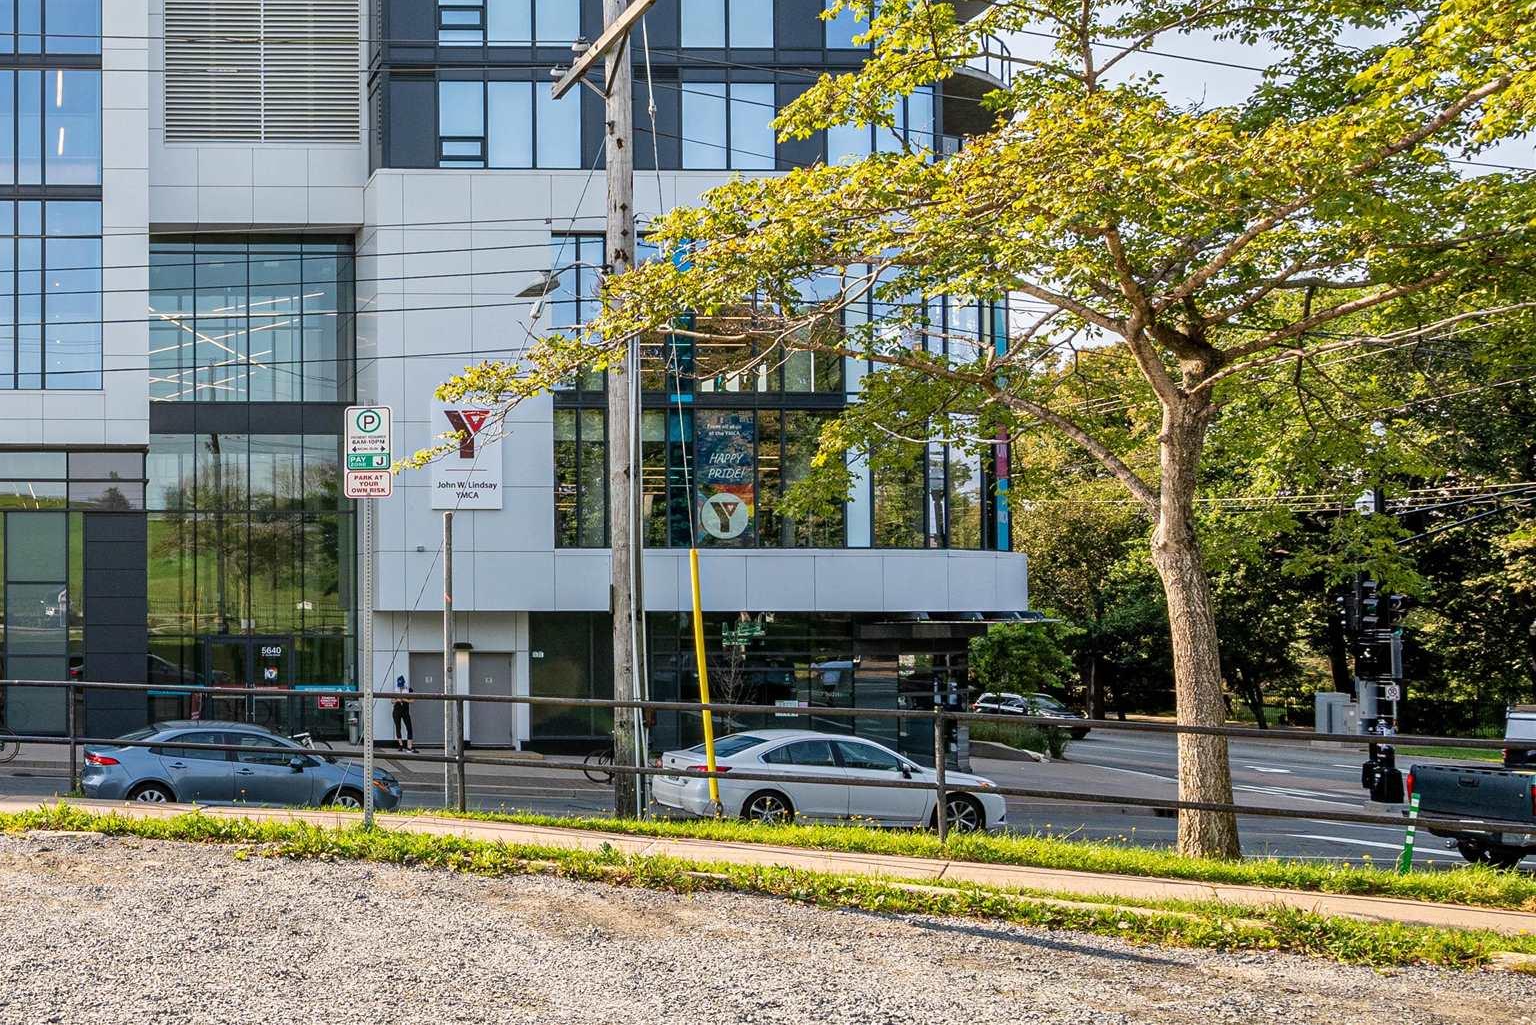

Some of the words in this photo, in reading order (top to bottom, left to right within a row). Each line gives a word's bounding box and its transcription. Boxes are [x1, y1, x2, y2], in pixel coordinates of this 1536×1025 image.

[364, 415, 375, 429] P
[376, 456, 384, 466] J
[709, 453, 743, 463] HAPPY
[708, 468, 745, 478] PRIDE!
[468, 481, 497, 490] Lindsay
[261, 646, 282, 654] 5640
